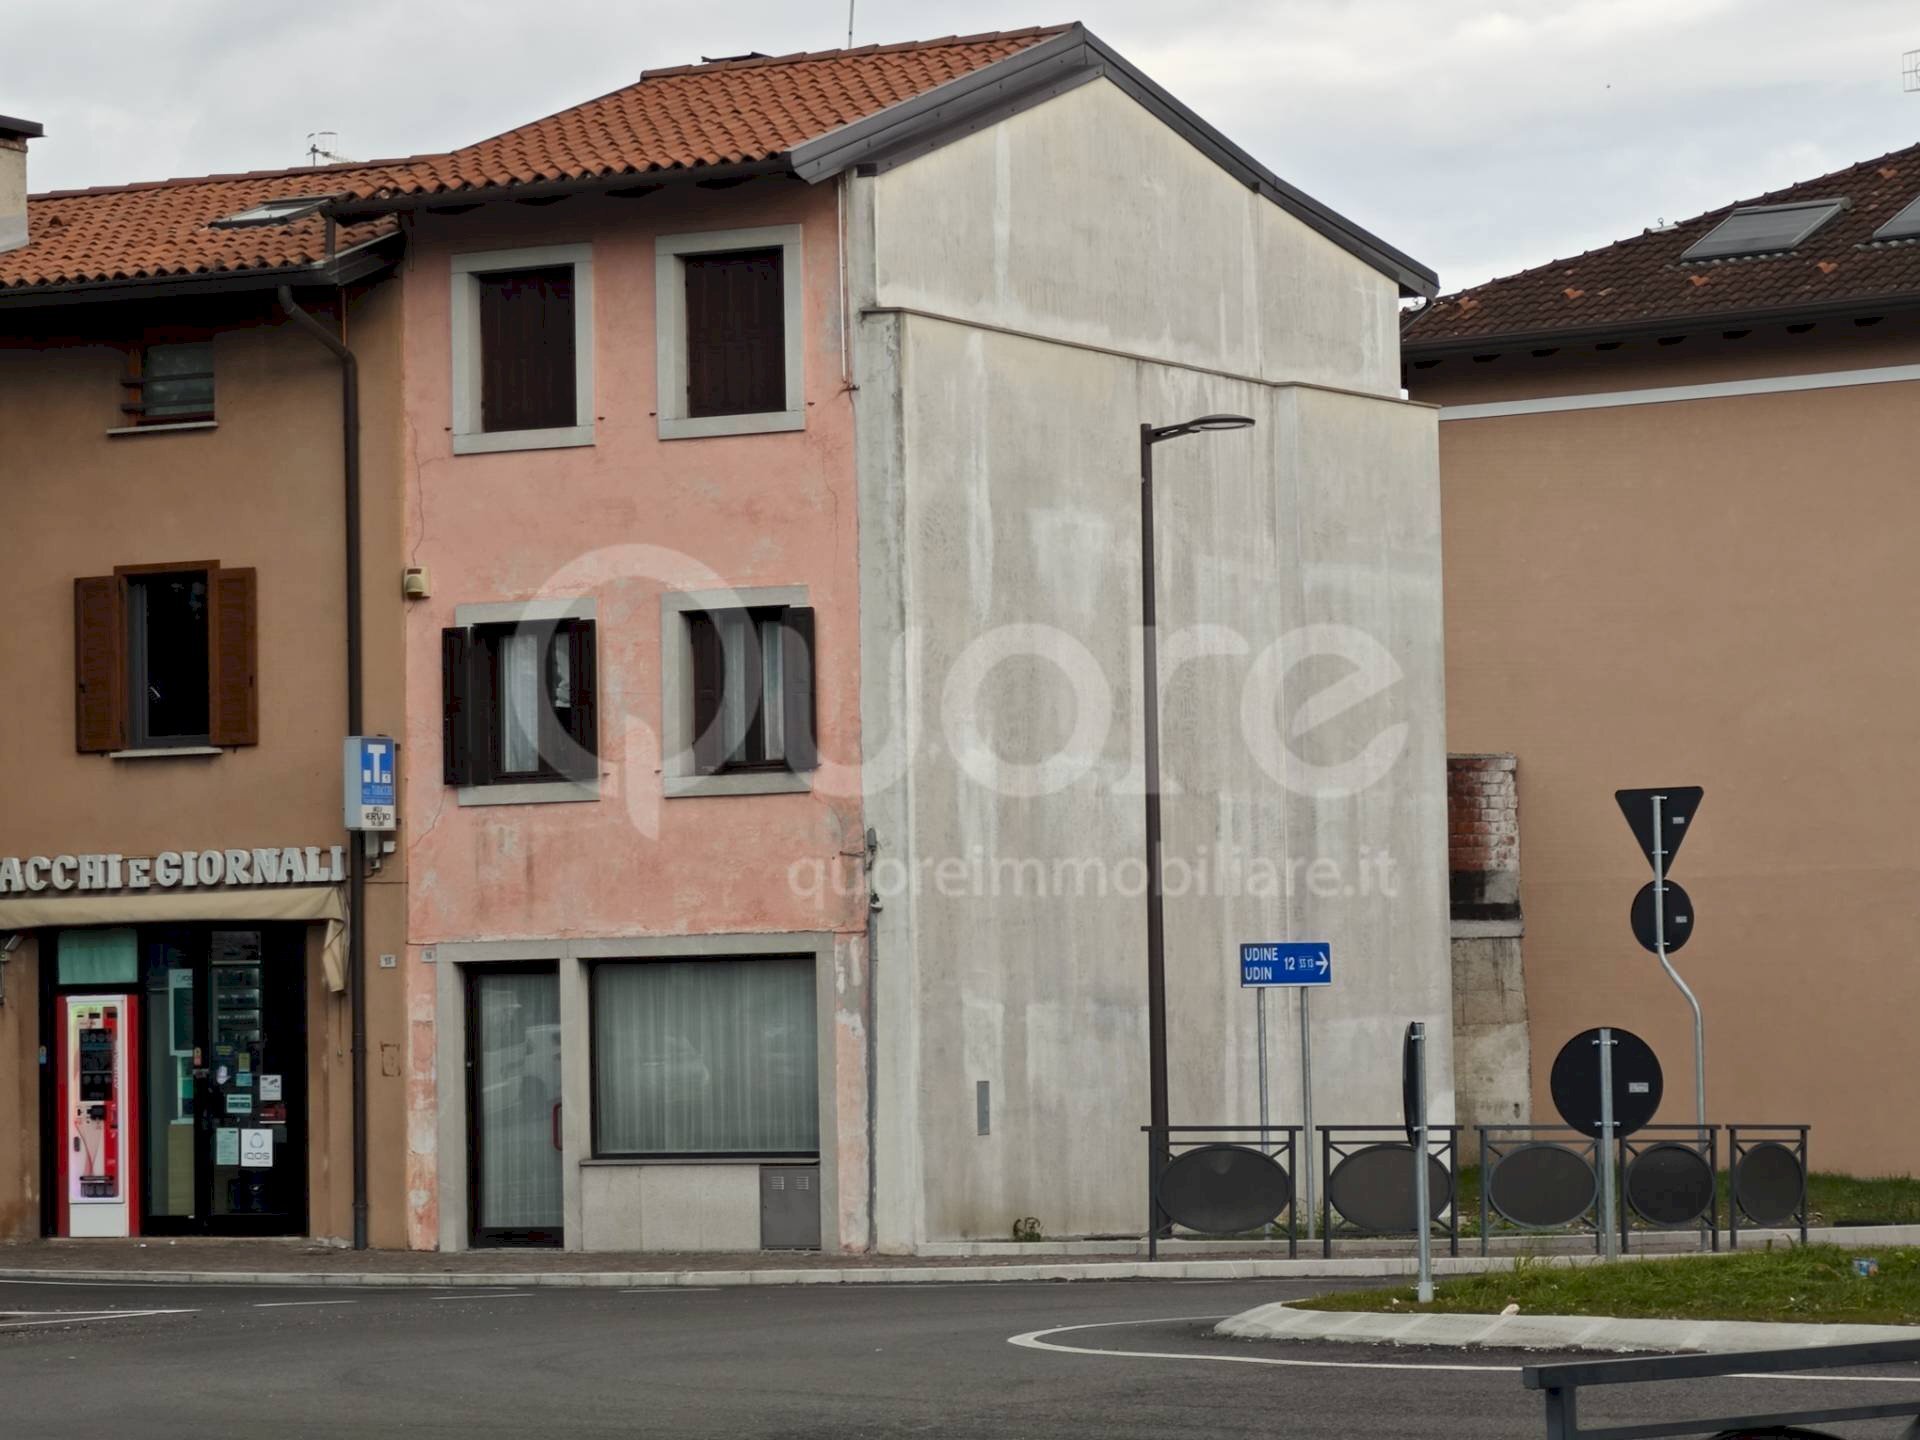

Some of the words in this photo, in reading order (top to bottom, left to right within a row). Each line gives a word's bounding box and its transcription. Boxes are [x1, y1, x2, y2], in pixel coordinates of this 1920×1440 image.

[0, 853, 123, 893] ACCHI
[155, 845, 347, 887] GIORNALI
[1244, 947, 1279, 962] UDINE
[1284, 957, 1296, 971] 12
[1244, 966, 1273, 980] UDIN
